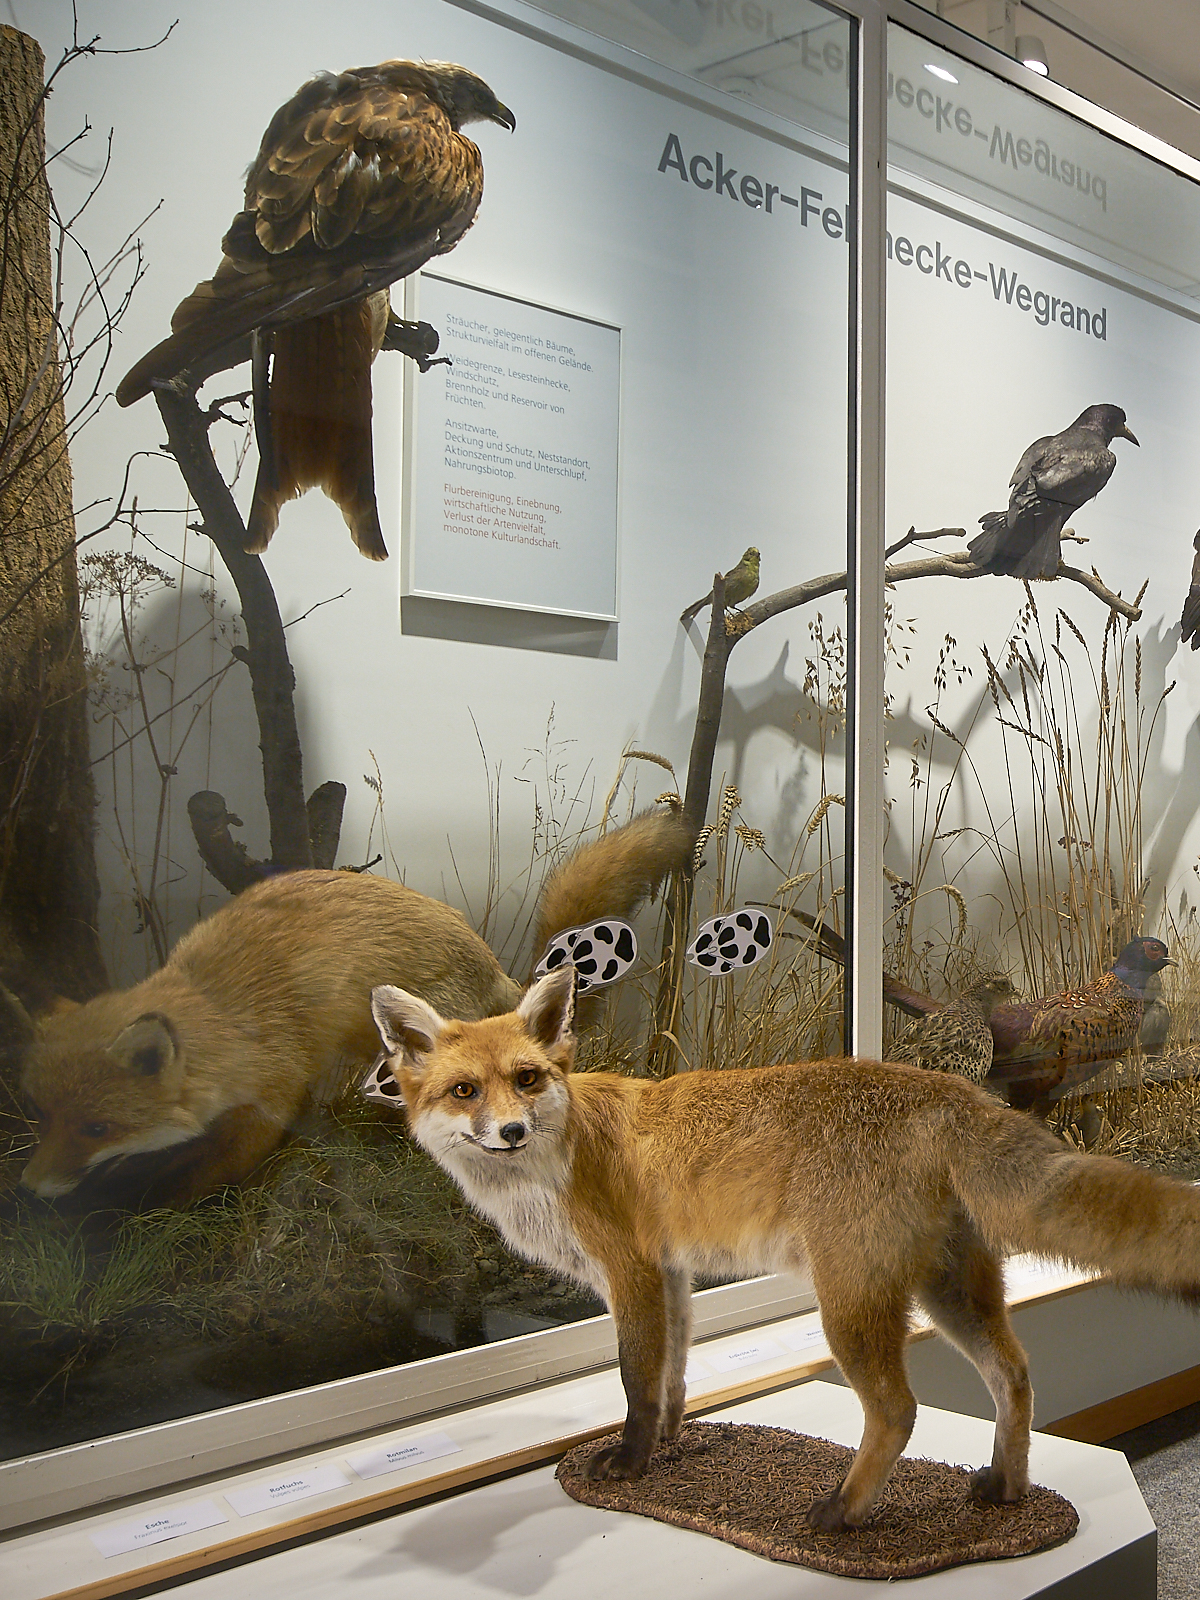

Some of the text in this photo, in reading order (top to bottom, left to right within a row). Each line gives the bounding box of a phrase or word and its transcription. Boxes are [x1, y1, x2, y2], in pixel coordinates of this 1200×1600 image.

[446, 313, 576, 356] Sträucher, gelegentlich Bäume,
[446, 326, 594, 373] Strukturvielfalt im offenen Gelände.
[445, 365, 499, 388] Windschutz,
[508, 368, 571, 393] Lesesteinhecke,
[445, 378, 565, 414] Brennholz und Reservoir von
[445, 391, 487, 410] Früchten.
[445, 418, 499, 438] Ansitzwarte,
[444, 430, 591, 470] Deckung und Schutz, Neststandort,
[444, 444, 587, 482] Aktionszentrum und Unterschlupf,
[444, 457, 517, 480] Nahrungsbiotop.
[443, 498, 547, 524] wirtschaftliche Nutzung,
[444, 483, 562, 514] Flurbereinigung, Einebnung,
[443, 509, 546, 536] Verlust der Artenvielfalt,
[443, 523, 561, 550] monotone Kulturlandschaft.
[269, 1480, 304, 1493] Rotfuchs
[145, 1519, 170, 1530] Esche
